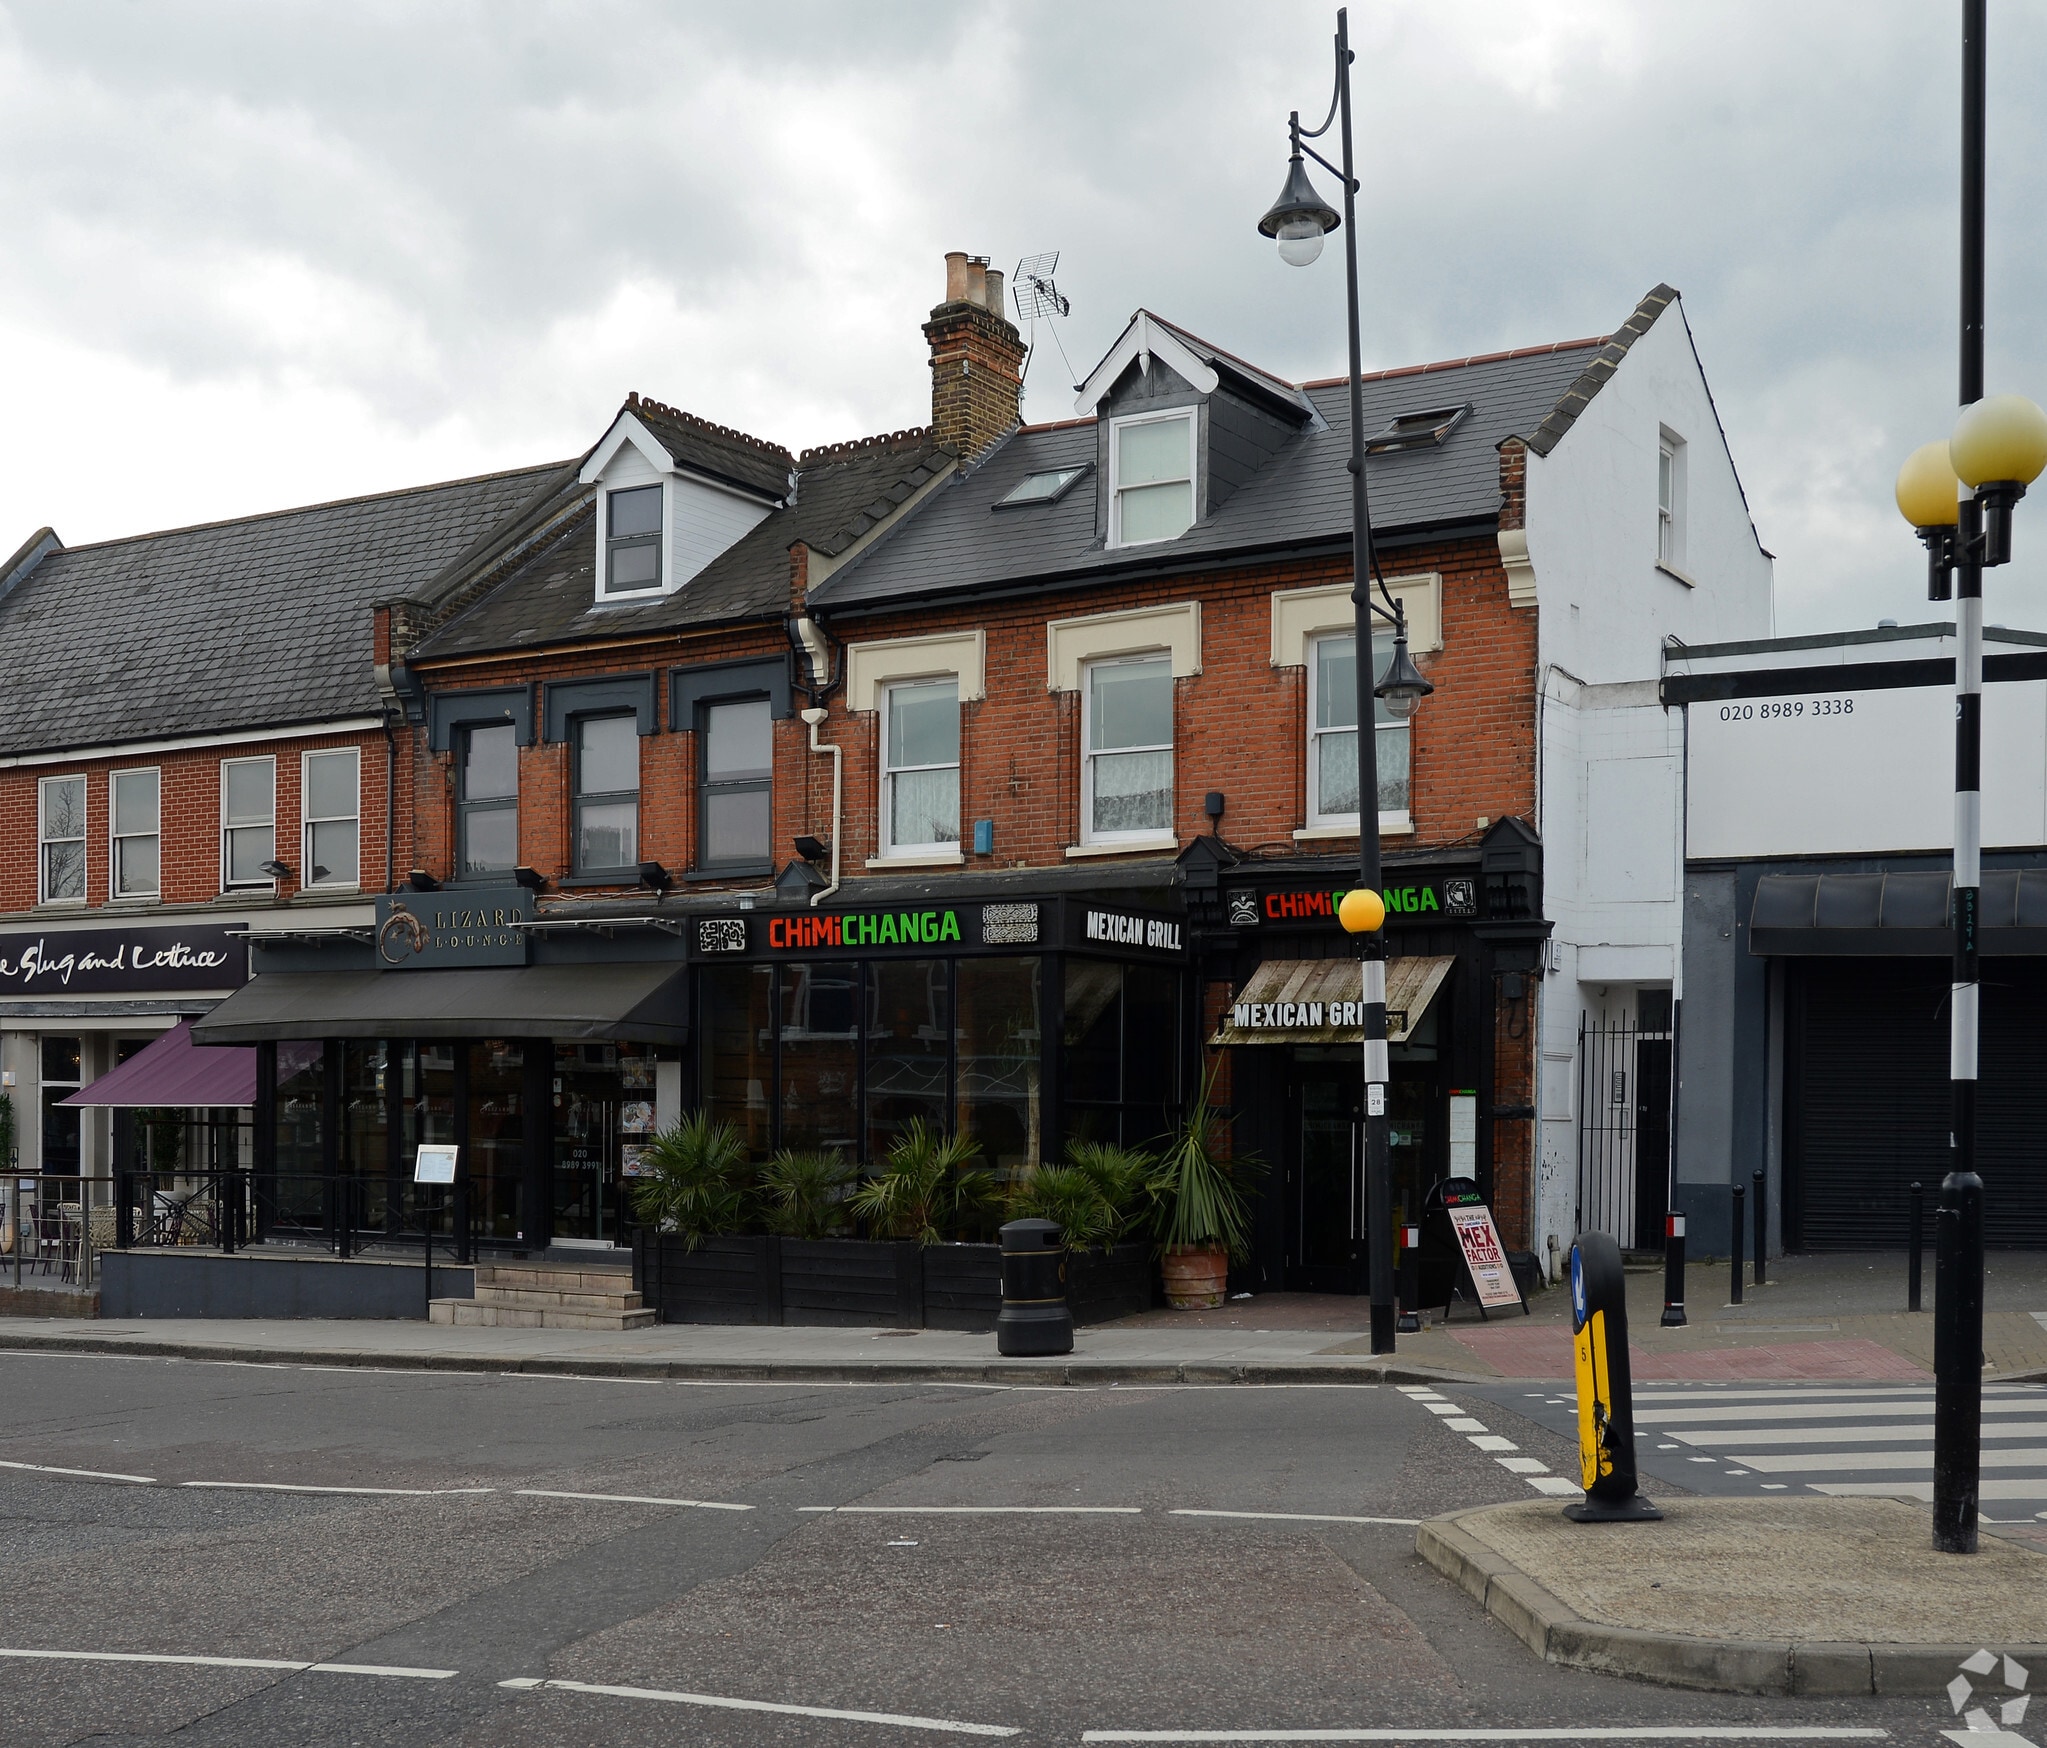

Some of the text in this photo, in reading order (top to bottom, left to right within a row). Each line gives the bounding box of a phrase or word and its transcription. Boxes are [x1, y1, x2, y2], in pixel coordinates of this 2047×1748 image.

[1720, 699, 1854, 721] 020 8989 3338
[436, 908, 523, 929] LIZARD
[1087, 911, 1182, 950] MEXICAN GRILL
[20, 938, 74, 985] Slug
[78, 944, 125, 970] and
[132, 942, 228, 969] Lettuce
[1234, 1002, 1323, 1027] MEXICAN
[572, 1149, 588, 1158] 020
[562, 1161, 579, 1169] 8989
[1457, 1225, 1496, 1248] MEX
[1466, 1247, 1501, 1262] FACTOR
[1581, 1347, 1587, 1362] 5
